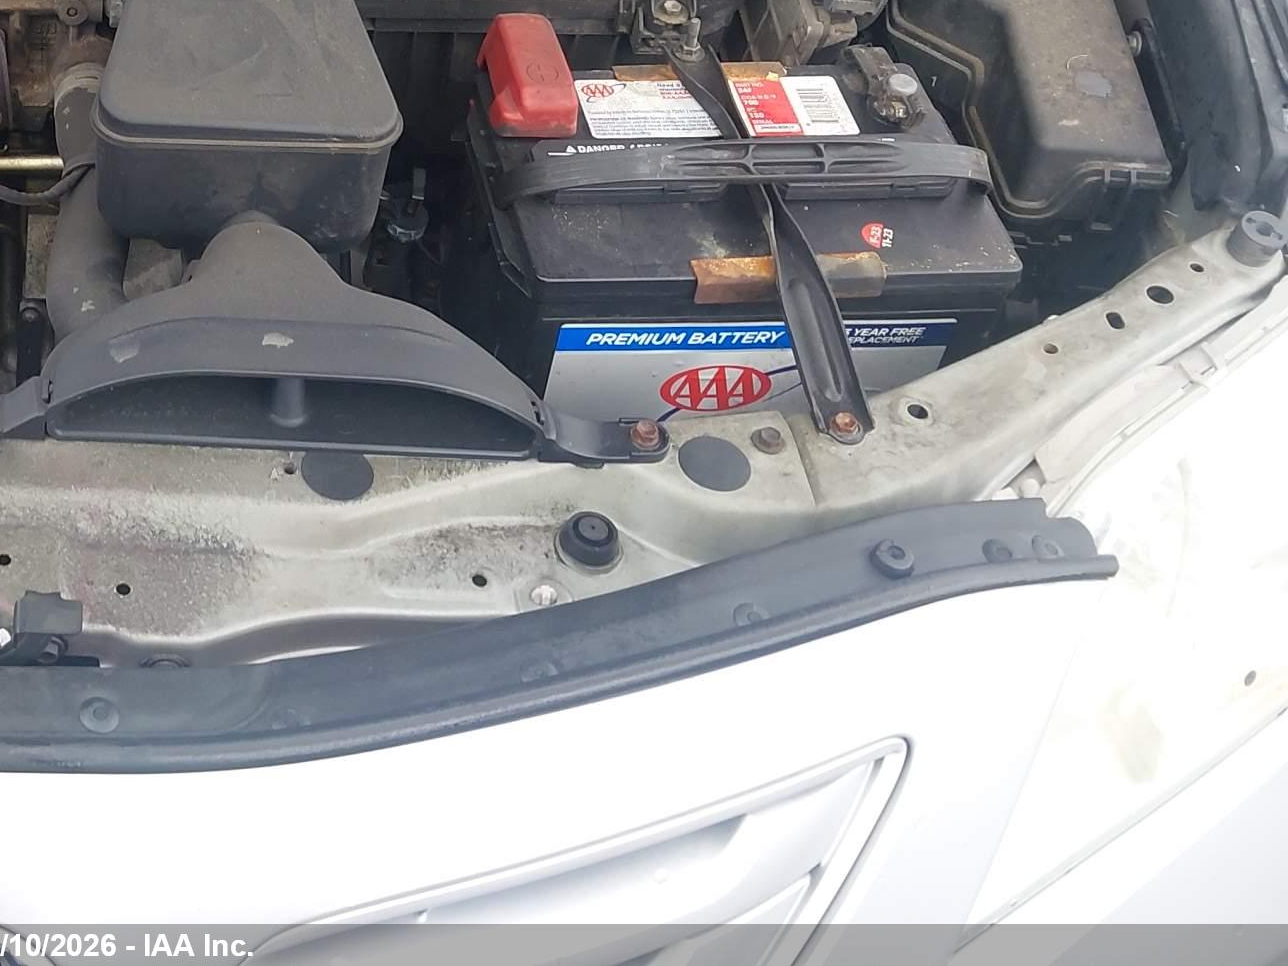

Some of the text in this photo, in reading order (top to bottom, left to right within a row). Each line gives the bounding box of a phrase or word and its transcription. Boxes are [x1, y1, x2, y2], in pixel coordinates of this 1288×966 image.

[854, 327, 889, 337] YEAR
[889, 326, 927, 336] FREE
[586, 331, 786, 346] PREMIUM BATTERY
[846, 336, 920, 345] EPLACEMENT
[658, 365, 773, 413] AAA
